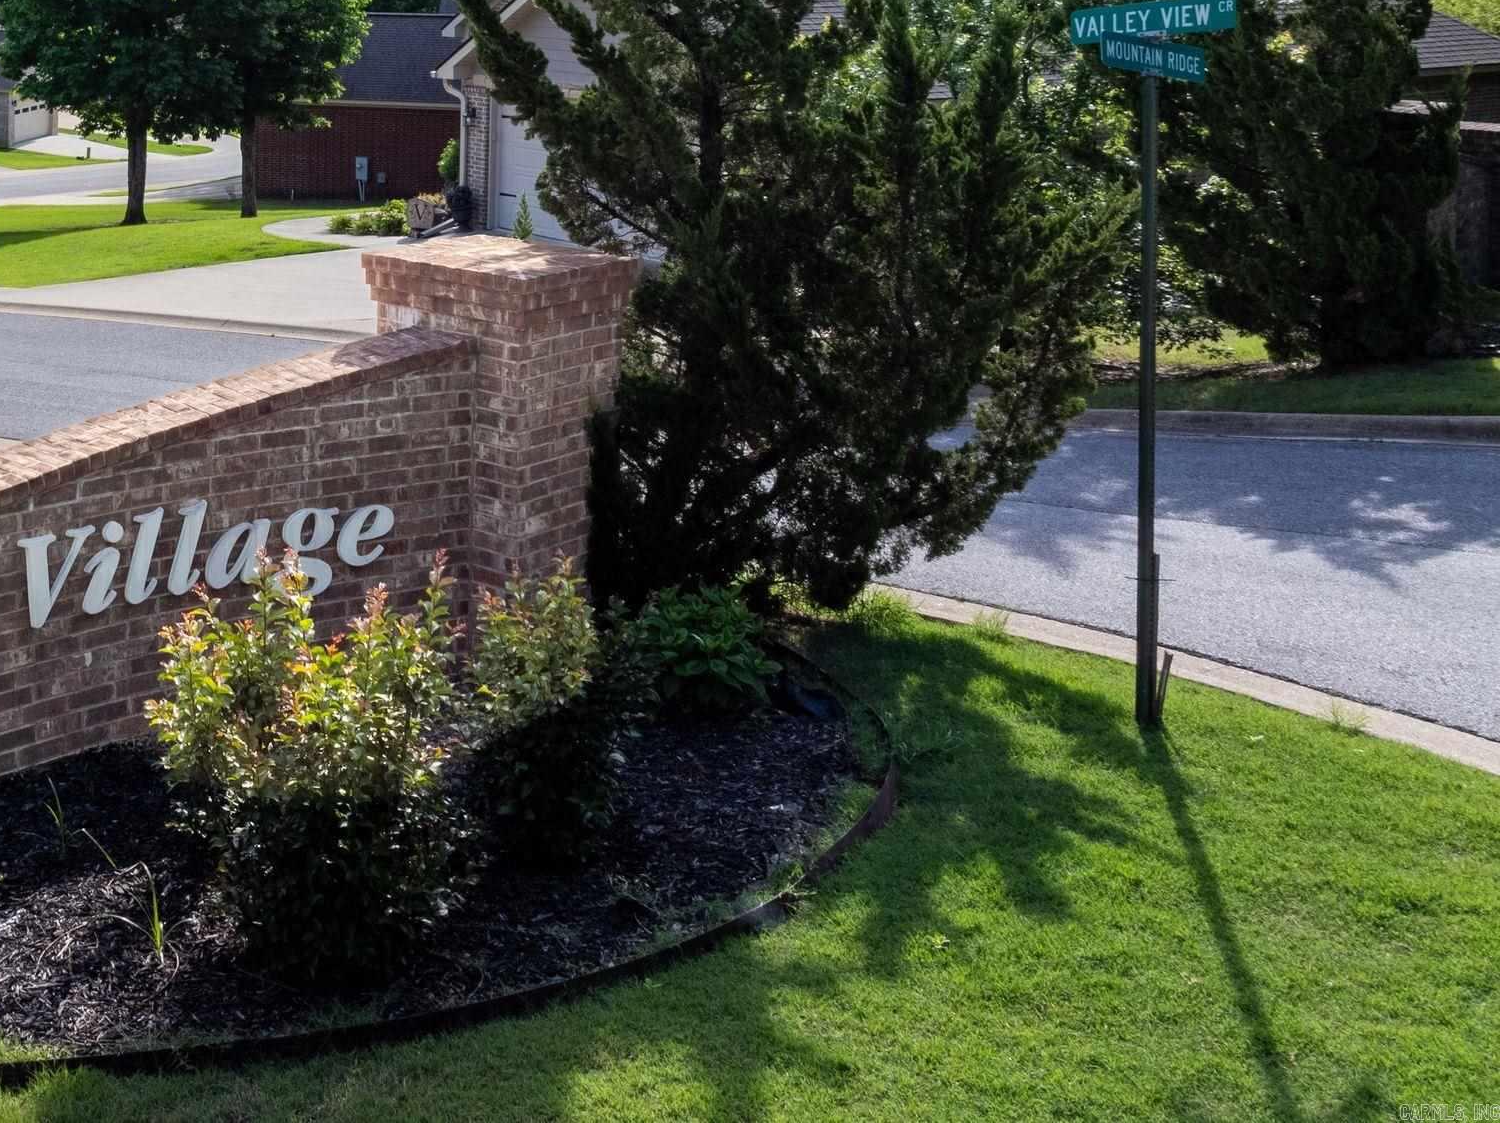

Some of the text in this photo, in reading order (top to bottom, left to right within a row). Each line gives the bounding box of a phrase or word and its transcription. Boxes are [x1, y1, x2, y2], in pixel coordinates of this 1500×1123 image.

[1074, 0, 1234, 38] VALLEY VIEW CR
[1106, 39, 1200, 75] MOUNTAIN RIDGE
[17, 498, 395, 629] Village
